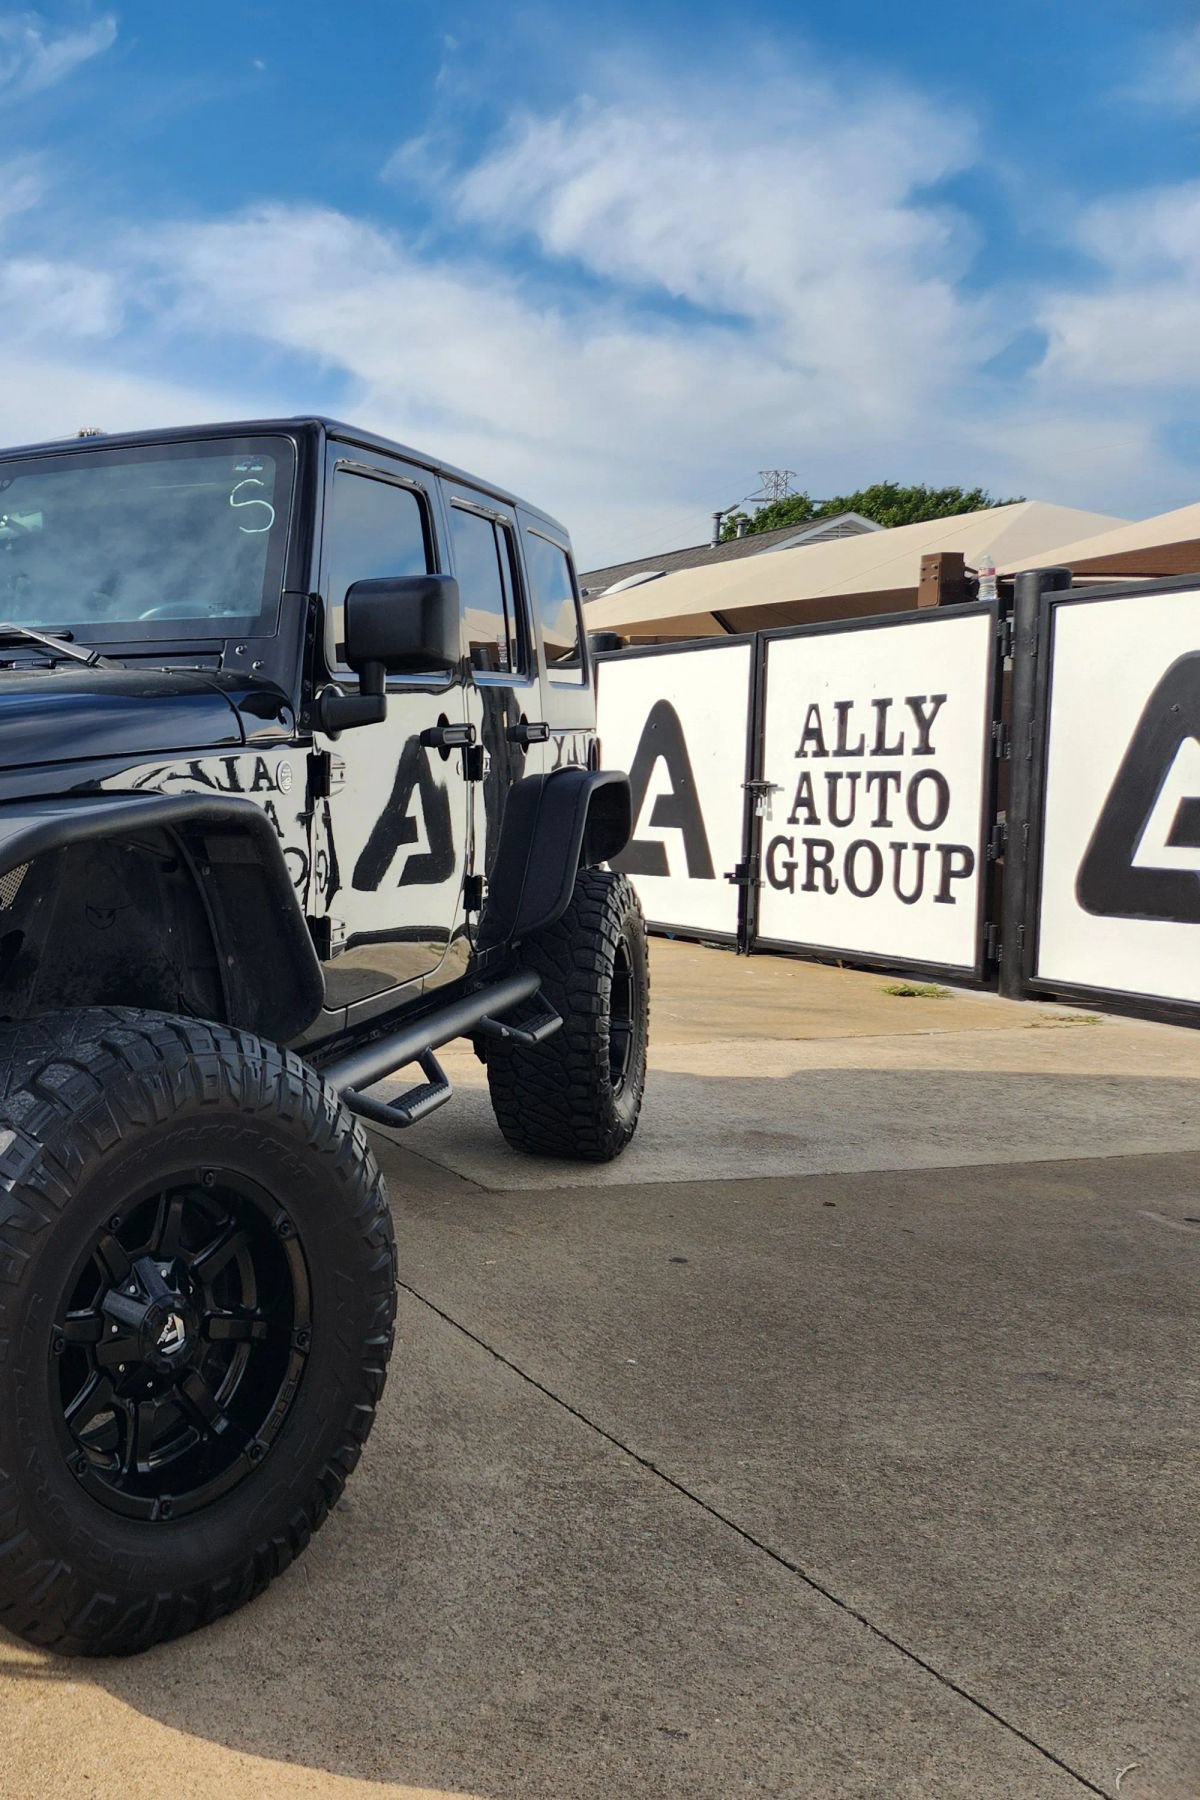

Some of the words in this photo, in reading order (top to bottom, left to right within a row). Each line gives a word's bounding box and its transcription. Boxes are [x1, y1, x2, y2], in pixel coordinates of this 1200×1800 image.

[794, 693, 948, 758] ALLY
[787, 768, 951, 832] AUTO
[765, 835, 975, 905] GROUP
